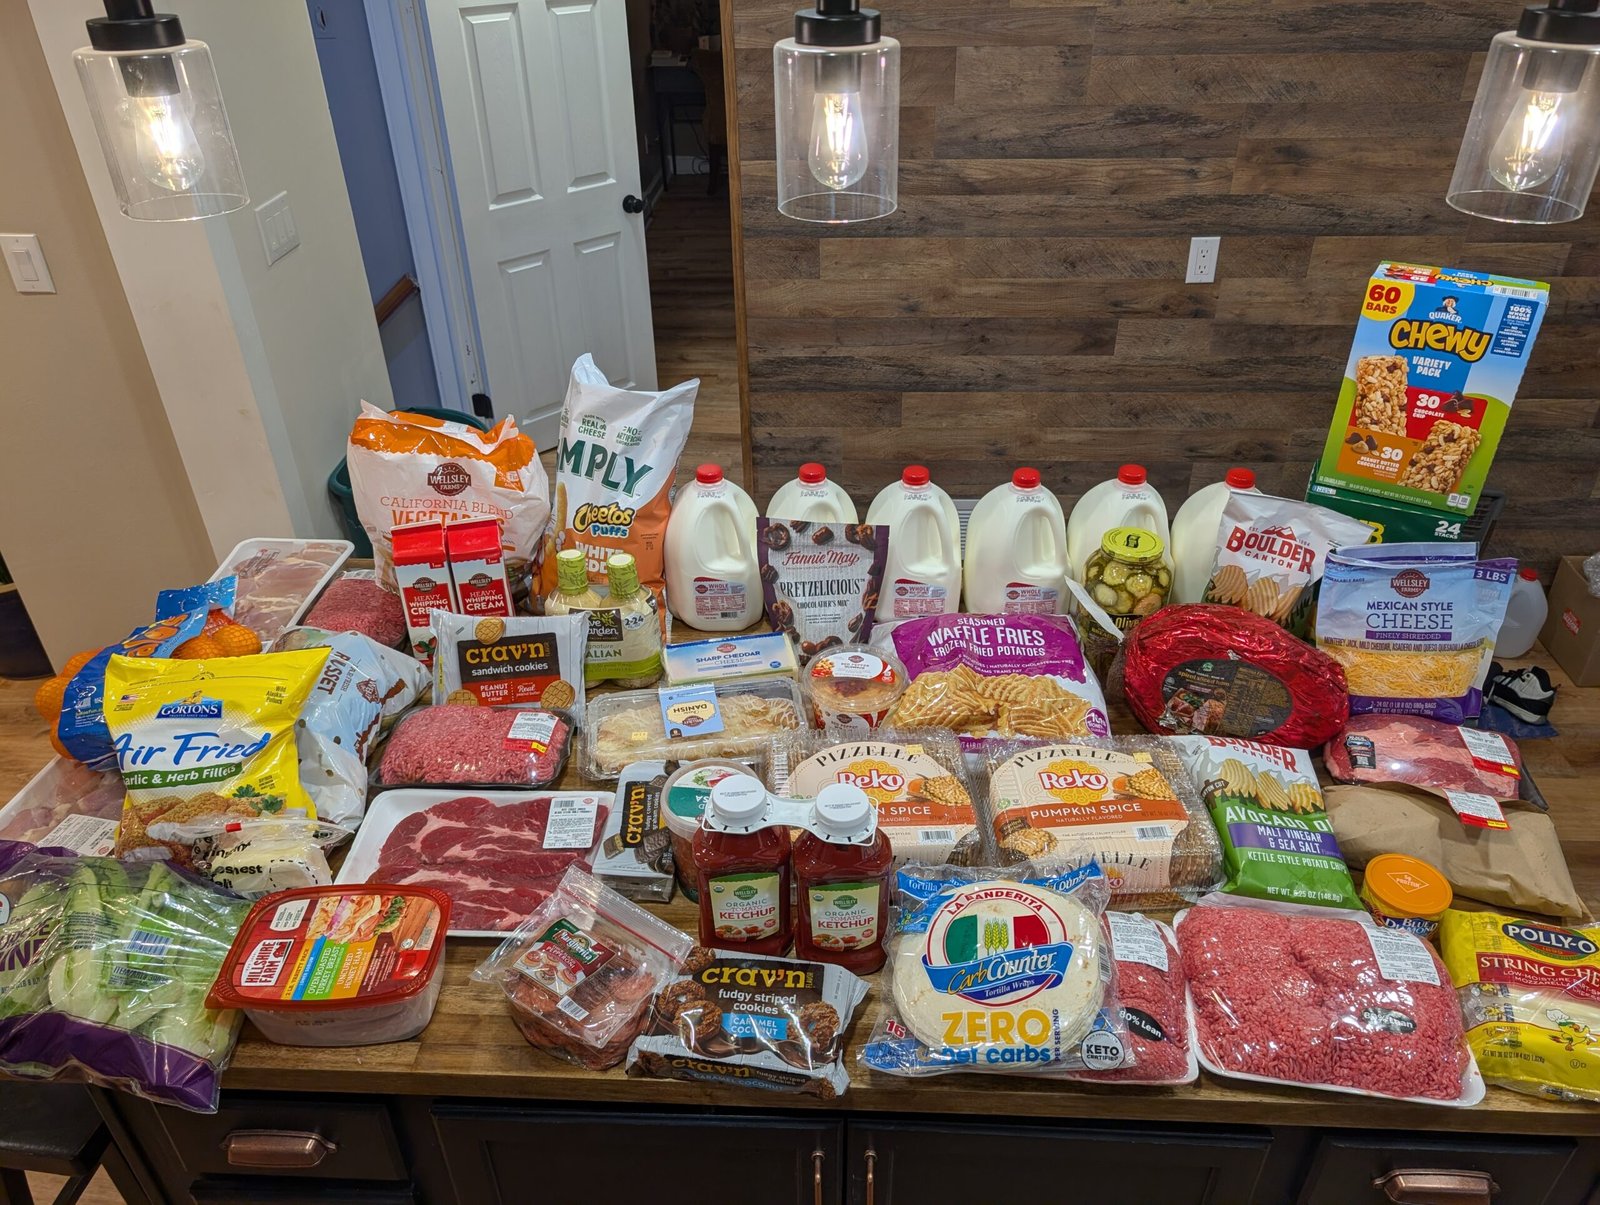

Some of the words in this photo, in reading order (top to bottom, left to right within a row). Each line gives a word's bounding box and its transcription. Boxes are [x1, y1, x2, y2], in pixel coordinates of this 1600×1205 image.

[1369, 284, 1401, 304] 60
[1366, 302, 1398, 315] BARS
[1509, 305, 1532, 314] 100%
[1428, 311, 1462, 323] QUAKER
[1412, 355, 1452, 370] VARIETY
[1416, 366, 1441, 378] PACK
[1416, 393, 1441, 409] 30
[1413, 408, 1445, 418] CHOCOLATE
[581, 418, 600, 430] REAL
[626, 427, 638, 436] NO
[577, 425, 607, 440] CHEESE
[1360, 456, 1381, 466] PEANUT
[1380, 446, 1403, 461] 30
[1356, 460, 1385, 471] CHOCOLATE
[429, 474, 470, 485] WELLSLEY
[440, 483, 462, 491] FARMS
[380, 496, 468, 512] CALIFORNIA
[471, 501, 514, 520] BLEND
[574, 502, 635, 533] Cheetos
[591, 524, 629, 537] Puffs
[1435, 520, 1461, 535] 24
[1434, 531, 1459, 540] STACKS
[1226, 526, 1316, 575] BOULDER
[782, 551, 826, 566] Fannie
[825, 550, 861, 567] May
[1244, 550, 1294, 569] CANYON
[1392, 578, 1428, 588] WELLSLEY
[1476, 569, 1484, 578] 3
[1486, 571, 1507, 582] LBS
[470, 590, 496, 598] HEAVY
[780, 579, 861, 598] PRETZELICIOUS
[409, 599, 448, 608] WHIPPING
[465, 594, 504, 604] WHIPPING
[1366, 601, 1417, 611] MEXICAN
[1421, 602, 1453, 611] STYLE
[466, 602, 505, 612] CREAM
[624, 617, 645, 626] 2-24
[957, 617, 1005, 627] SEASONED
[1366, 612, 1453, 630] CHEESE
[927, 625, 991, 647] WAFFLE
[996, 626, 1046, 647] FRIES
[1400, 632, 1442, 641] SHREDDED
[933, 638, 968, 658] FROZEN
[969, 643, 994, 657] FRIED
[997, 645, 1046, 657] POTATOES
[1323, 636, 1346, 646] MONTEREY
[1359, 640, 1371, 649] MILD
[1392, 642, 1413, 652] ASADERO
[1412, 642, 1423, 651] AND
[1423, 643, 1438, 652] QUESO
[466, 641, 544, 665] crav'n
[585, 649, 622, 662] ALIAN
[696, 655, 722, 663] SHARP
[723, 651, 761, 659] CHEDDAR
[317, 651, 351, 695] RUSSET
[471, 664, 513, 677] sandwich
[514, 661, 549, 673] cookies
[480, 683, 508, 692] PEANUT
[481, 689, 509, 698] BUTTER
[673, 704, 708, 713] DANISH
[114, 733, 167, 770] Air
[173, 732, 272, 766] Fried
[816, 746, 918, 767] PIZZELLE
[1014, 748, 1118, 769] PIZZELLE
[1232, 745, 1280, 766] CANYON
[151, 774, 163, 784] &
[167, 771, 199, 782] Herb
[202, 765, 236, 779] Fillets
[838, 769, 905, 792] Reko
[1039, 767, 1108, 792] Reko
[626, 787, 645, 844] crav'n
[890, 806, 932, 815] SPICE
[1030, 806, 1096, 820] PUMPKIN
[1100, 802, 1143, 813] SPICE
[1055, 816, 1090, 824] NATURALLY
[1226, 807, 1310, 830] AVOCADO
[1257, 825, 1282, 838] MALT
[1285, 829, 1323, 843] VINEGAR
[1269, 839, 1276, 849] &
[1279, 840, 1296, 852] SEA
[1299, 842, 1321, 854] SALT
[1248, 851, 1275, 863] KETTLE
[1277, 854, 1301, 866] STYLE
[1302, 857, 1329, 869] POTATO
[1330, 860, 1348, 874] CHIPS
[1267, 886, 1279, 895] NET
[1280, 887, 1293, 896] WT.
[1308, 891, 1317, 899] OZ
[726, 898, 767, 908] ORGANIC
[948, 901, 962, 915] LA
[964, 890, 1044, 912] BANDERITA
[719, 906, 776, 920] KETCHUP
[824, 908, 867, 916] ORGANIC
[817, 916, 875, 929] KETCHUP
[1403, 918, 1431, 930] BLUE
[1507, 924, 1597, 955] POLLY-O
[245, 941, 277, 984] HILLSHIRE
[302, 948, 310, 962] PACK
[354, 948, 364, 965] HAM
[259, 960, 281, 984] FARM
[308, 976, 319, 994] OVEN
[316, 947, 332, 977] ROASTED
[315, 969, 330, 995] TURKEY
[327, 946, 341, 969] BREAST
[337, 952, 354, 985] UNCURED
[1481, 956, 1555, 977] STRING
[702, 967, 805, 988] crav'n
[1503, 970, 1571, 983] LOW-MOISTURE
[1514, 976, 1572, 987] MOZZARELLA
[984, 984, 1012, 998] Tortilla
[1012, 979, 1036, 993] Wraps
[718, 989, 752, 1002] fudgy
[754, 993, 797, 1005] striped
[733, 1001, 779, 1015] cookies
[733, 1017, 777, 1028] CARAMEL
[885, 1019, 905, 1039] 16
[941, 1009, 1051, 1046] ZERO
[1120, 1010, 1140, 1026] 80%
[1141, 1020, 1162, 1038] Lean
[731, 1025, 778, 1036] COCONUT
[986, 1045, 1051, 1063] carbs
[1053, 1045, 1061, 1062] PER
[1086, 1045, 1119, 1056] KETO
[1086, 1054, 1119, 1062] CERTIFIED
[671, 1059, 751, 1078] crav'n
[755, 1069, 778, 1079] fudgy
[778, 1073, 806, 1083] striped
[693, 1073, 735, 1085] CARAMEL
[737, 1079, 784, 1091] COCONUT
